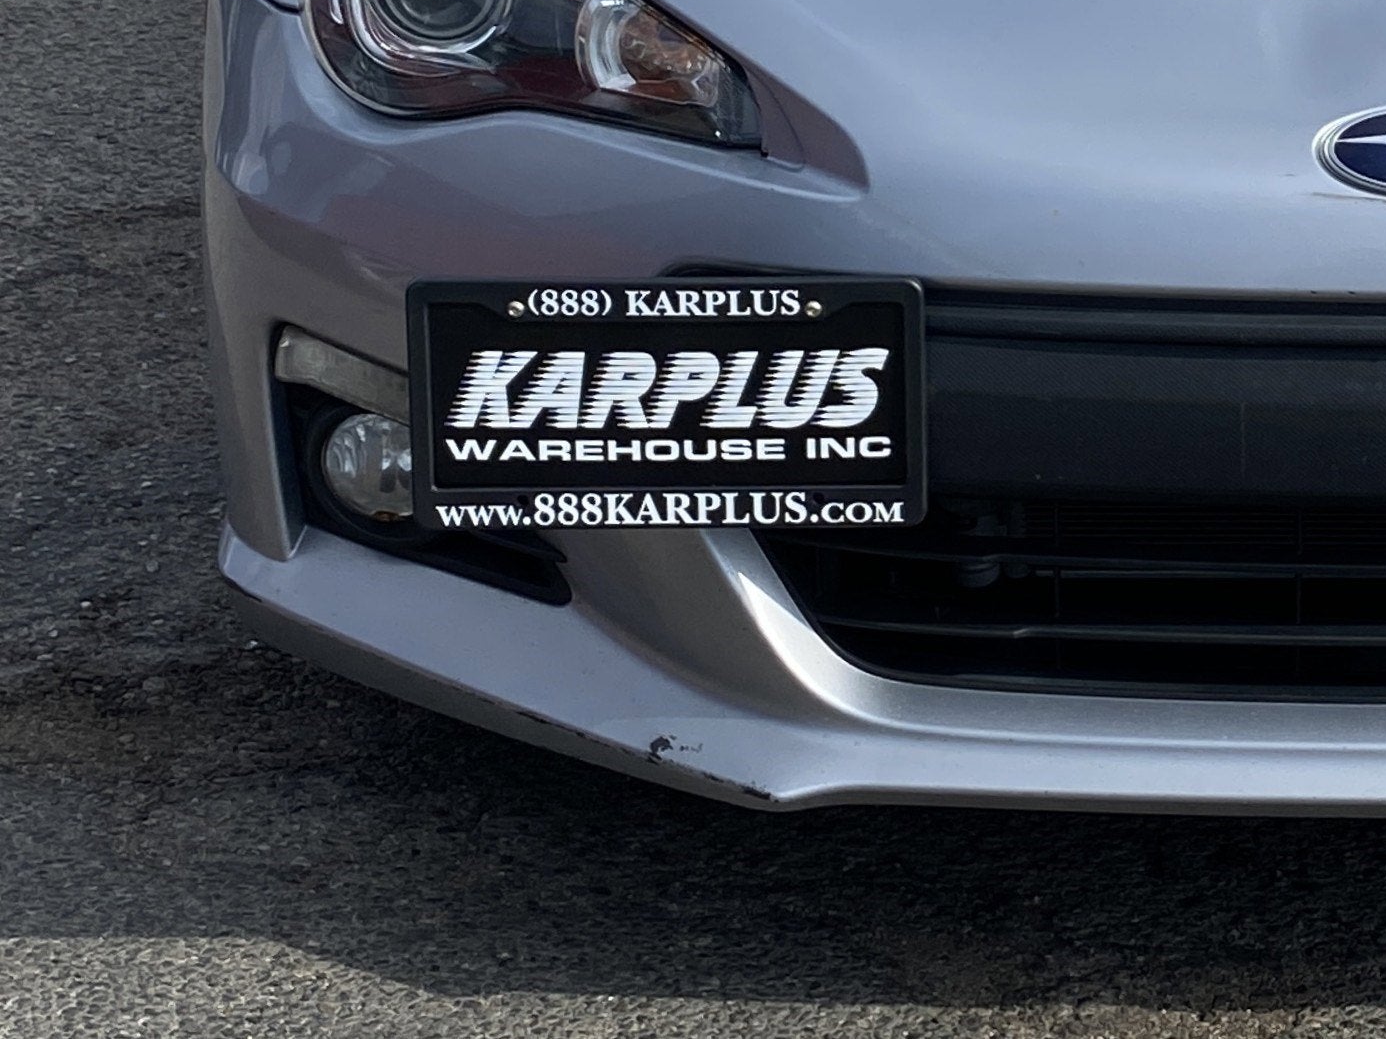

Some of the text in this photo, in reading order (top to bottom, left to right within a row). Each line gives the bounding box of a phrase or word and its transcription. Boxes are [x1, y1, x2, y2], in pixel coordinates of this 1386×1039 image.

[527, 289, 800, 317] (888) KARPLUS
[443, 347, 889, 429] KARPLUS
[445, 437, 893, 461] WAREHOUSE INC
